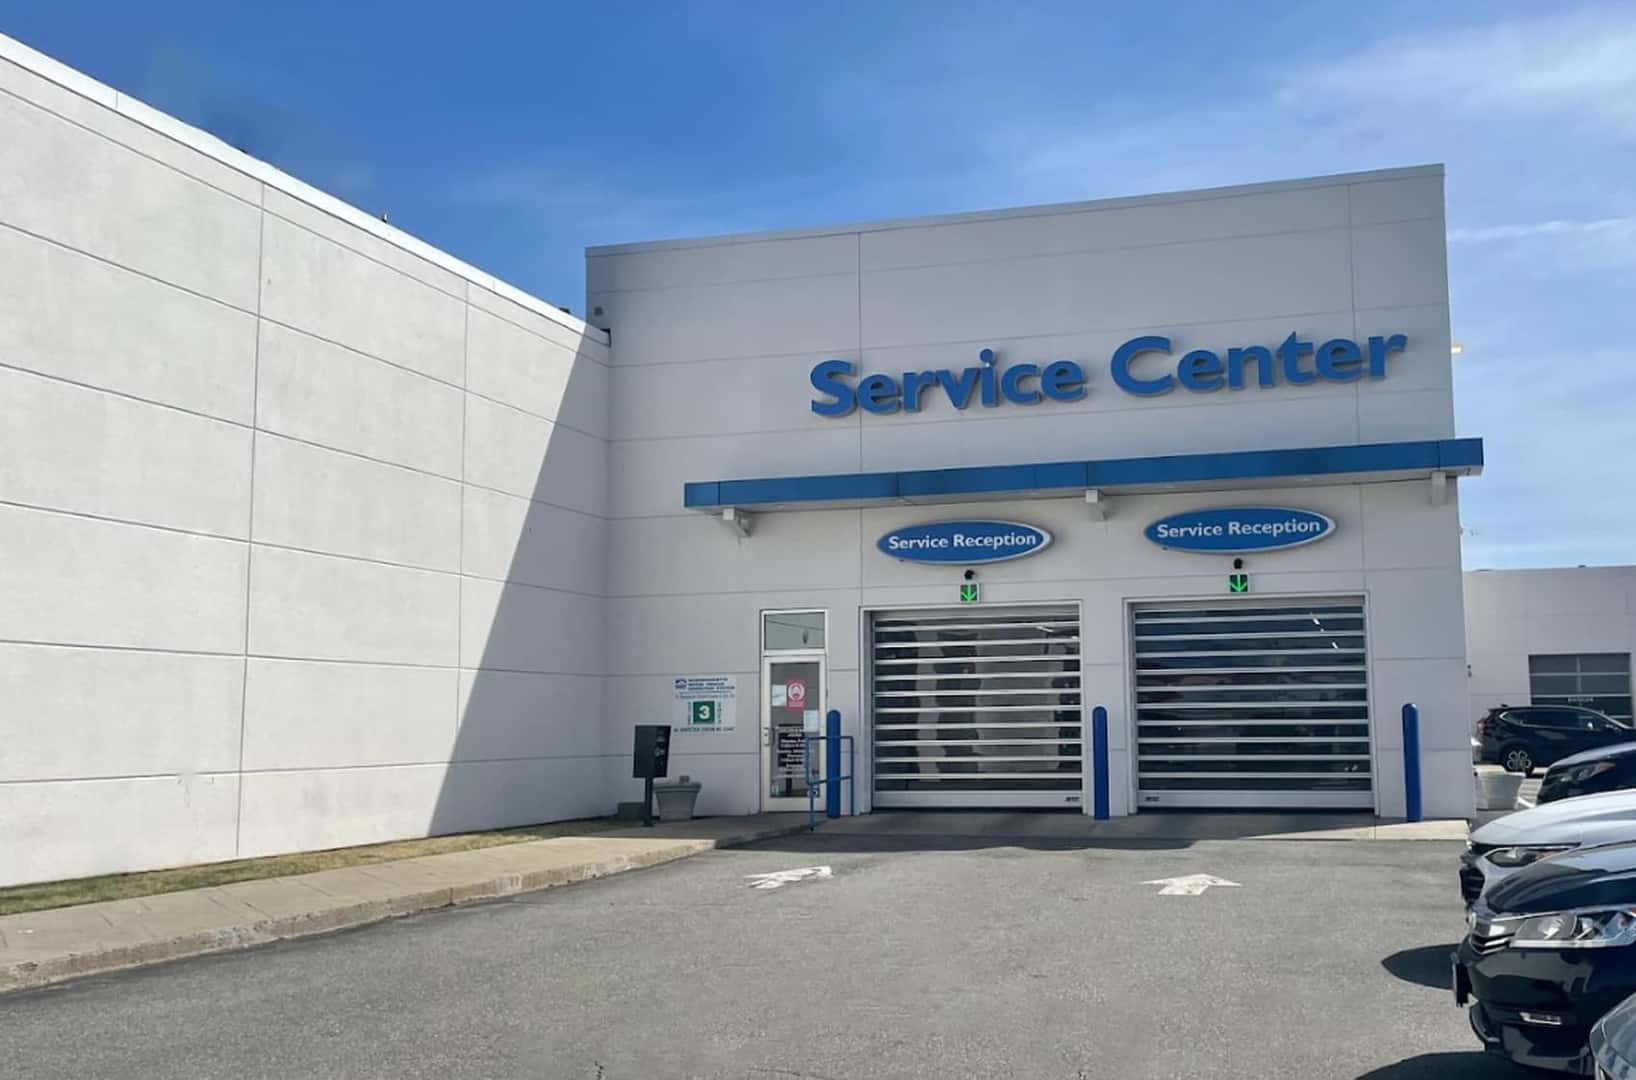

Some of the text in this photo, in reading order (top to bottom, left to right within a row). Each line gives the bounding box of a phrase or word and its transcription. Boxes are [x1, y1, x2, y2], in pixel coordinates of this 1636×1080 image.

[810, 332, 1408, 417] Service Center
[1156, 519, 1321, 539] Service Reception
[888, 532, 1037, 552] Service Reception
[698, 704, 711, 720] 3
